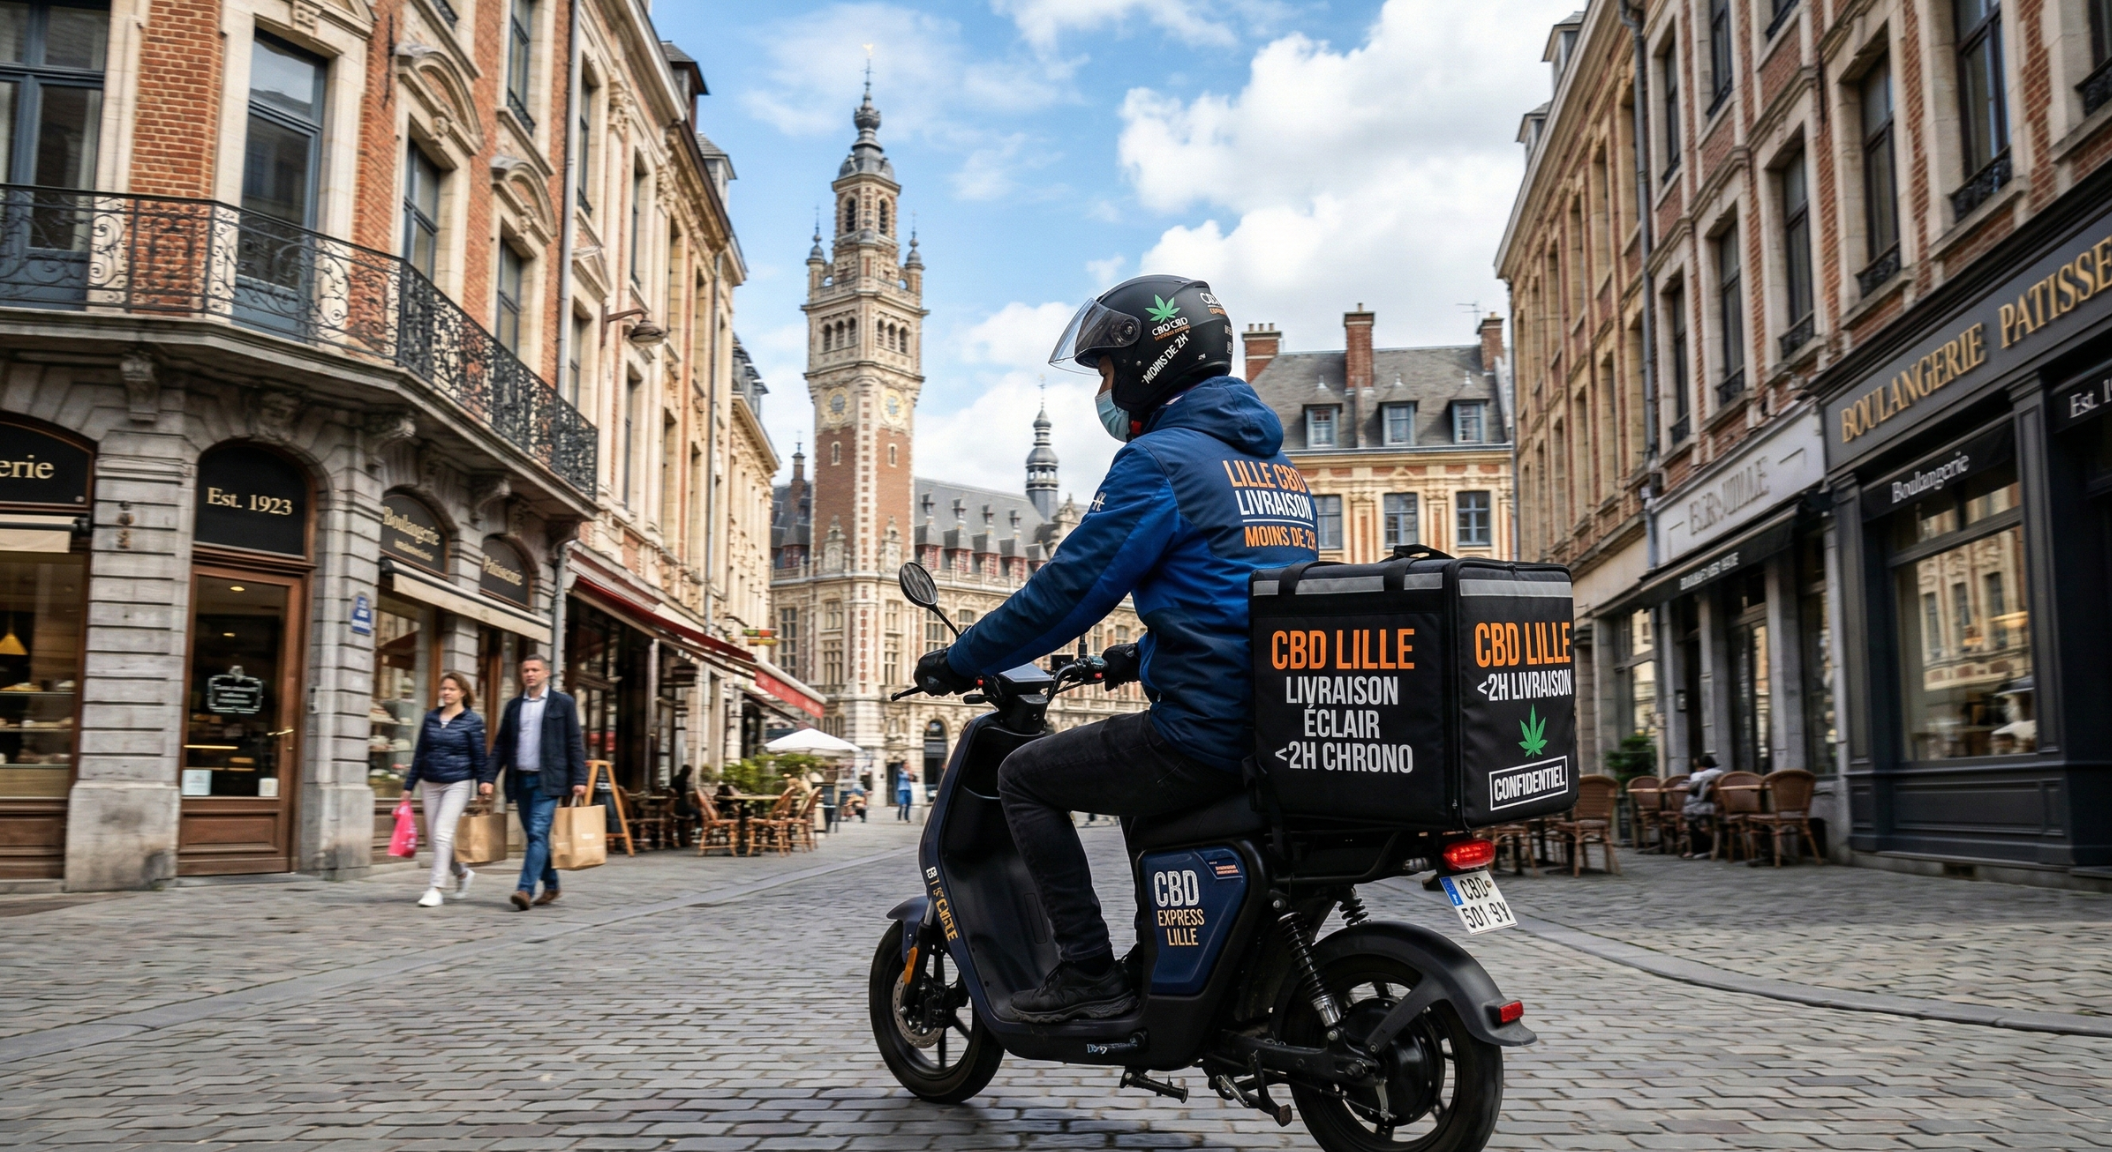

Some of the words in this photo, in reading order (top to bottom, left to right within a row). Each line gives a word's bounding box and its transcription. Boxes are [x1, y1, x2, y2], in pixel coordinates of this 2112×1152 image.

[1164, 344, 1179, 360] DE
[1174, 333, 1189, 349] 2H
[1840, 322, 1986, 443] BOULANGERIE
[1998, 234, 2112, 349] PATISSE
[1222, 460, 1276, 489] LILLE
[1272, 463, 1306, 493] CBD
[1892, 451, 1969, 504] Boulangerie
[248, 494, 293, 516] 1923
[1235, 490, 1313, 521] LIVRAISON
[1245, 526, 1290, 547] MOINS
[1290, 527, 1306, 548] DE
[1272, 630, 1327, 670] CBD
[1336, 628, 1415, 670] LILLE
[1475, 622, 1520, 668] CBD
[1524, 622, 1571, 665] LILLE
[1286, 676, 1399, 705] LIVRAISON
[1477, 673, 1509, 701] <2H
[1511, 669, 1572, 700] LIVRAISON
[1303, 703, 1380, 739] ÉCLAIR
[1274, 741, 1317, 770] <2H
[1322, 742, 1414, 774] CHRONO
[1494, 765, 1566, 802] CONFIDENTIEL
[1154, 869, 1200, 908] CBD
[1460, 876, 1489, 900] CBD
[1157, 908, 1205, 927] EXPRESS
[1166, 927, 1199, 946] LILLE
